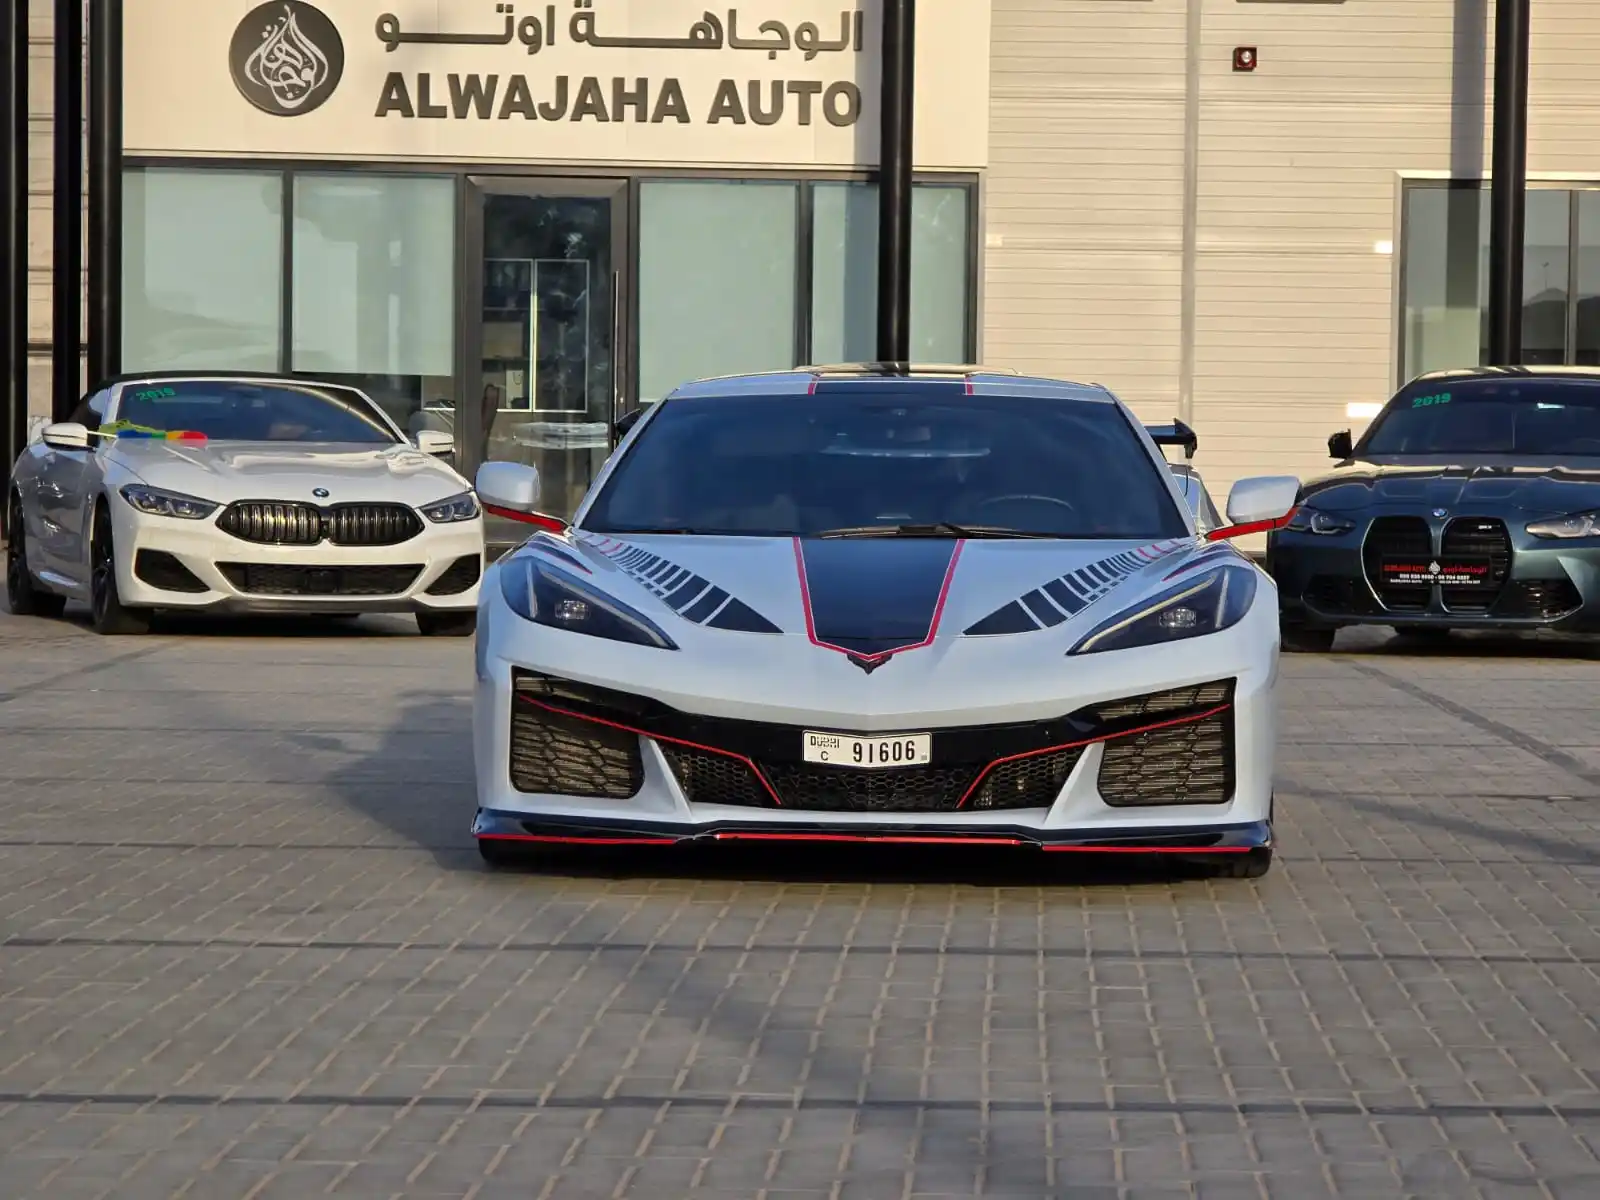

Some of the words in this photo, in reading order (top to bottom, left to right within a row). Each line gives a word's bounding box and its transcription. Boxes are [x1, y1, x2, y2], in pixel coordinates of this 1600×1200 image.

[569, 0, 863, 61] الوجاهة
[375, 71, 691, 123] ALWAJAHA
[707, 78, 862, 127] AUTO
[1412, 392, 1452, 408] 2019
[820, 751, 829, 761] C
[852, 740, 916, 763] 91606
